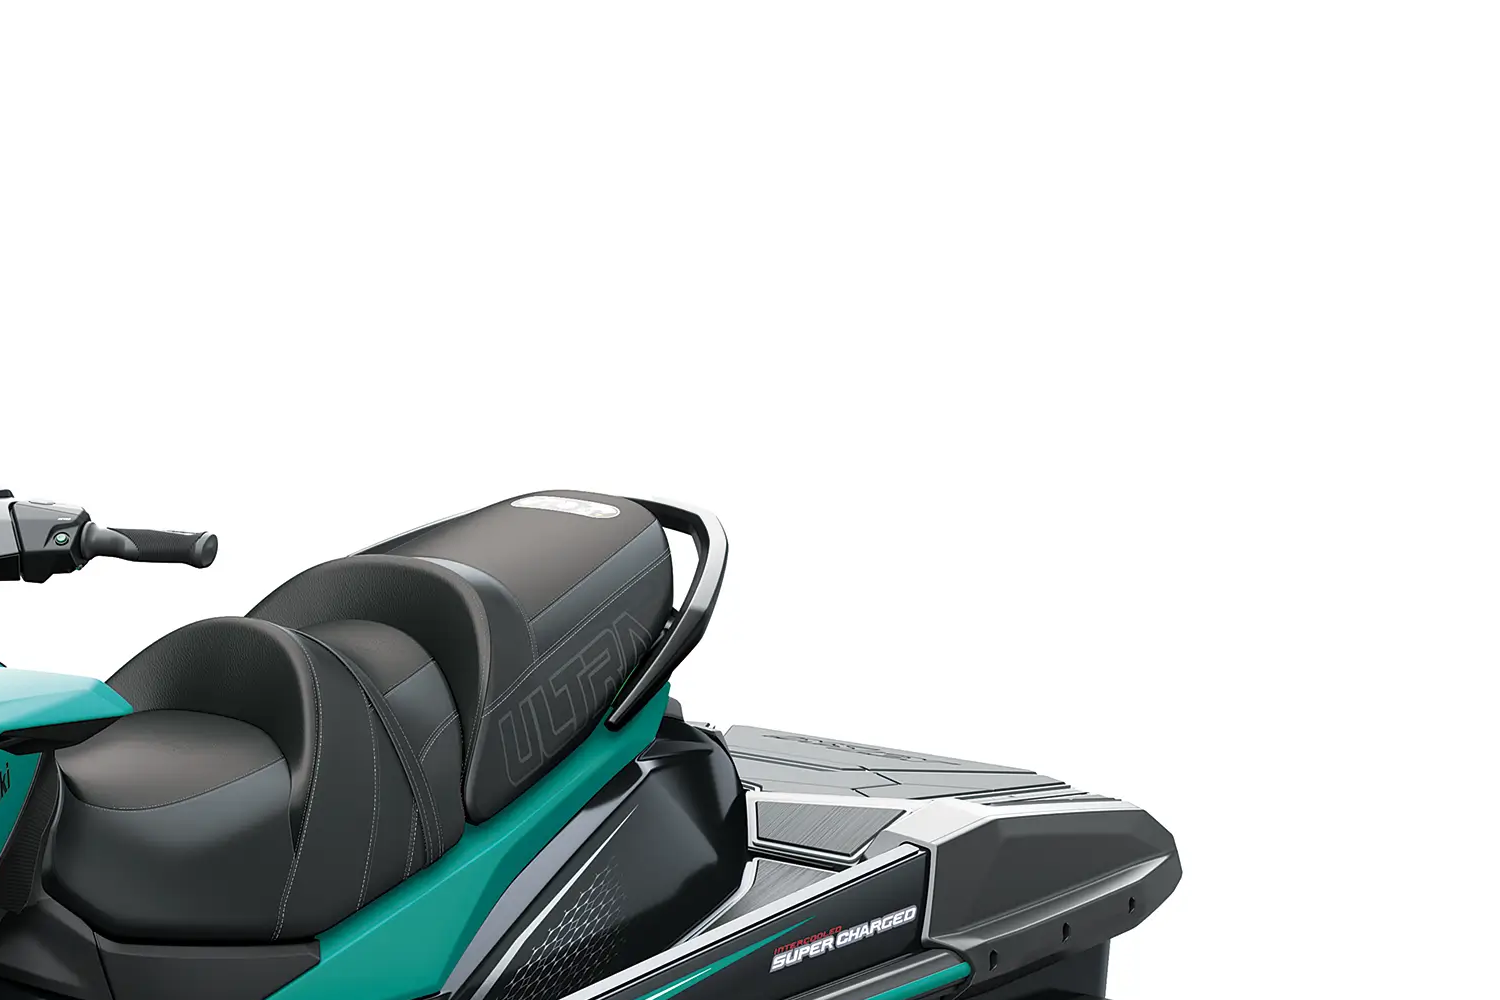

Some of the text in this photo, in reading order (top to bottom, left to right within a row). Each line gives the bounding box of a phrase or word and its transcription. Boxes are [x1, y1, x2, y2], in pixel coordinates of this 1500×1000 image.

[498, 611, 653, 787] ULTRA
[769, 905, 918, 973] SUPER CHARGED
[773, 925, 843, 955] INTERCOOLED
